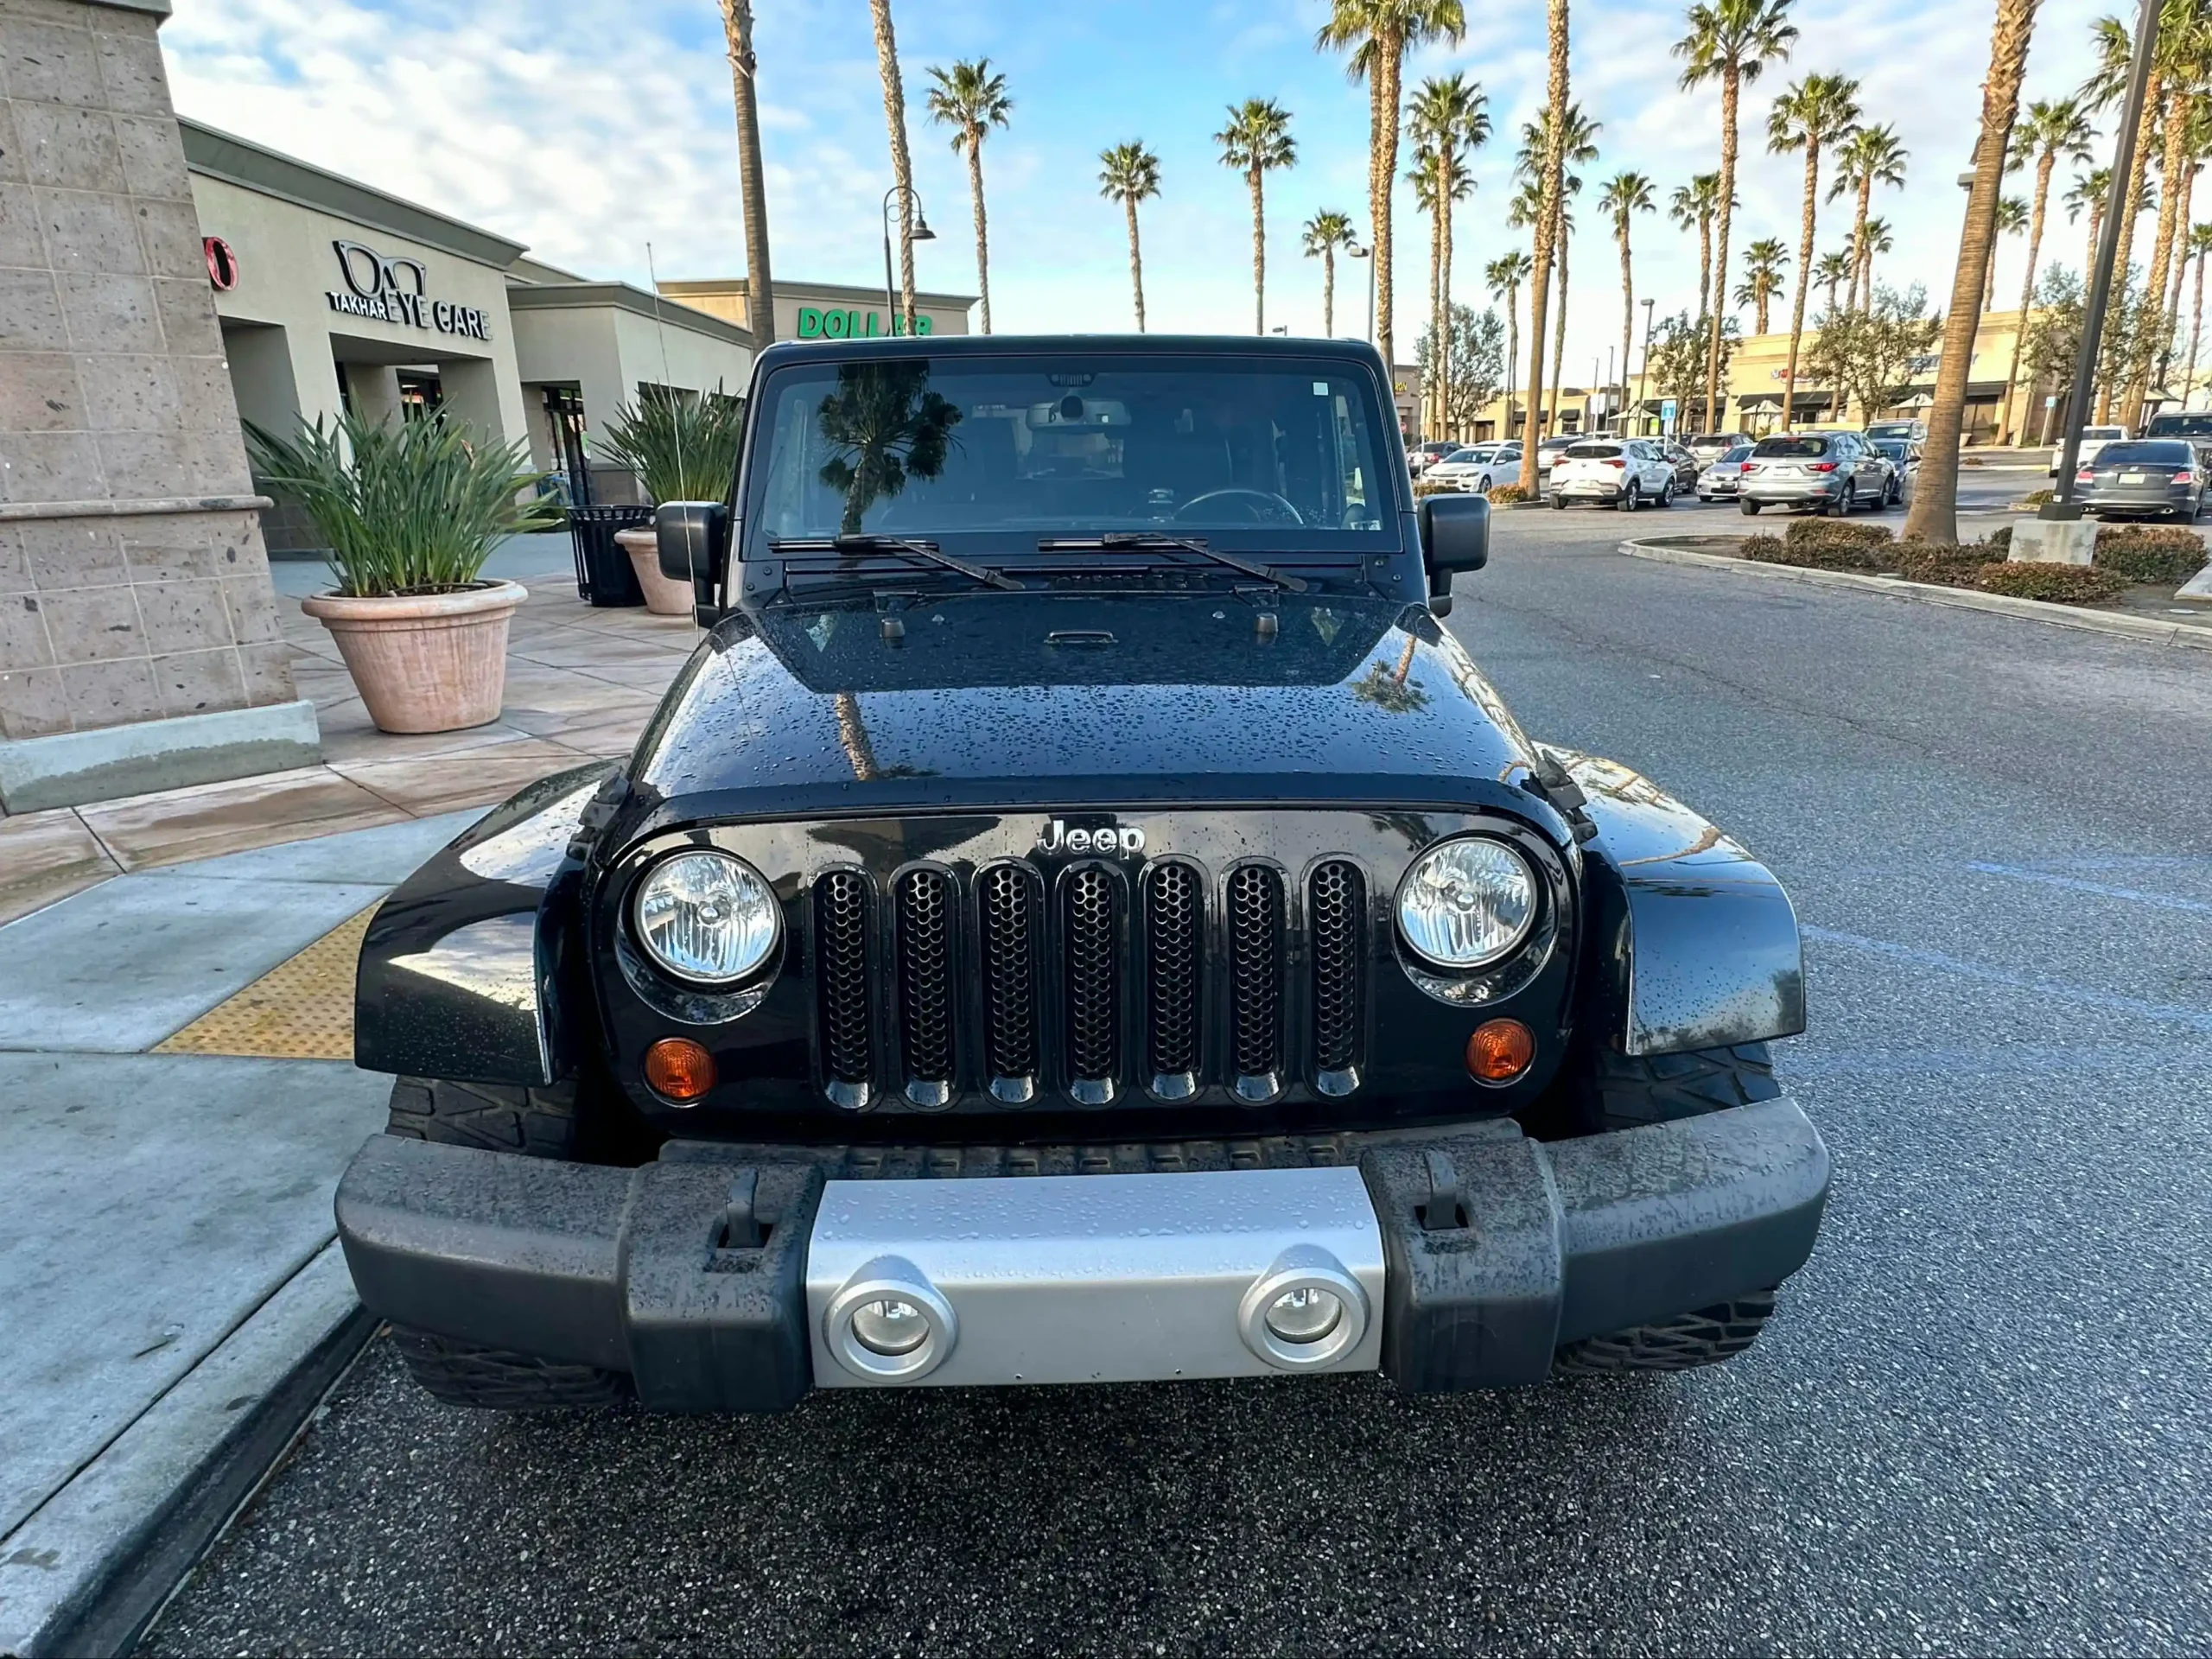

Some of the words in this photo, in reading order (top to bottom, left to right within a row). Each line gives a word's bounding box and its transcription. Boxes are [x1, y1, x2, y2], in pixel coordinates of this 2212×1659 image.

[327, 290, 389, 321] TAKHAR
[382, 287, 431, 328] EYE
[434, 301, 493, 340] CARE
[1037, 820, 1146, 860] Jeep
